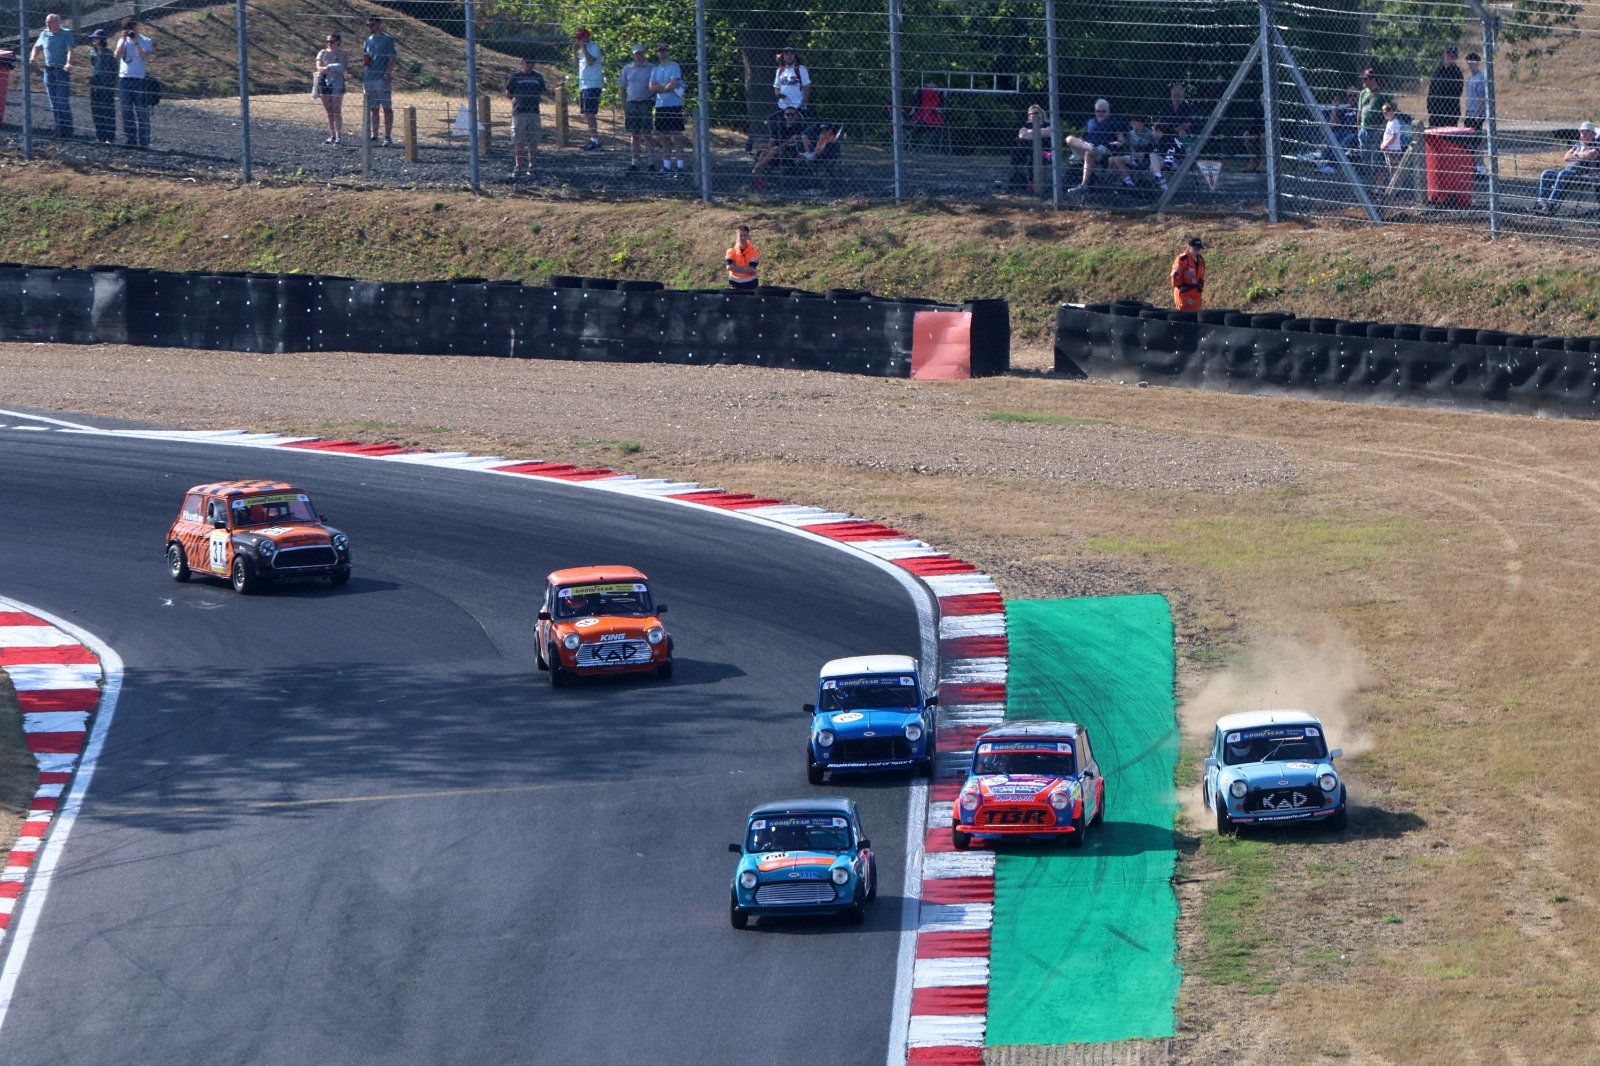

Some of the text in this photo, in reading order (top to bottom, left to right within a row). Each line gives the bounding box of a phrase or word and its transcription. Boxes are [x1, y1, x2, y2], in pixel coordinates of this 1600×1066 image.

[212, 540, 223, 564] 37
[575, 585, 614, 594] GOODYEAR
[600, 633, 626, 642] KING
[591, 643, 638, 662] KAD
[839, 678, 879, 687] GOODYEAR
[1244, 728, 1284, 739] GOODYEAR
[994, 742, 1035, 750] GOODYEAR
[1262, 791, 1308, 810] KAD
[984, 809, 1048, 825] TBR
[769, 818, 810, 827] GOODYEAR
